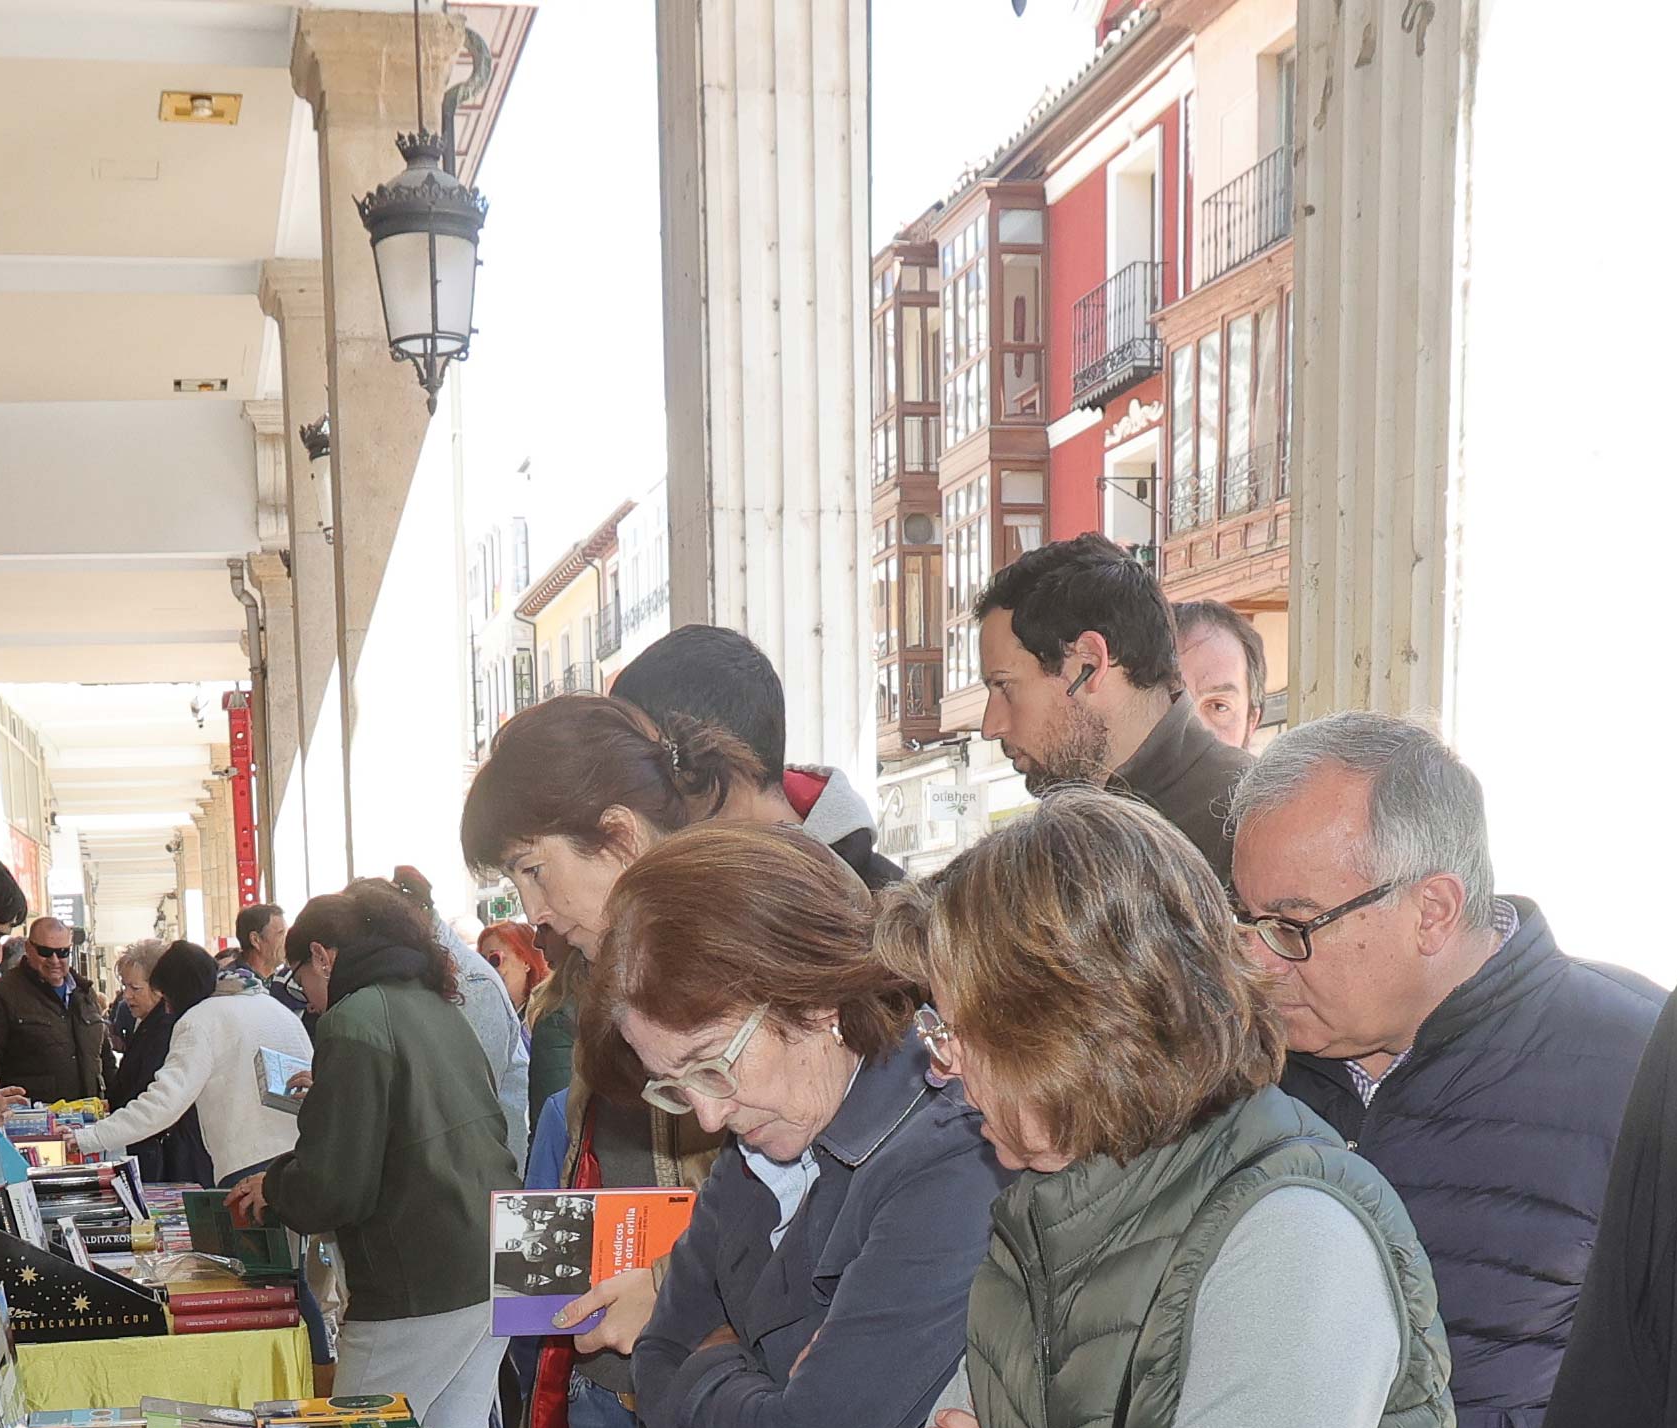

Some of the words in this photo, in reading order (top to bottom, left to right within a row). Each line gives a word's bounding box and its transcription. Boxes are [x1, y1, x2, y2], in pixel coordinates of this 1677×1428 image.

[626, 1206, 637, 1234] orilla
[611, 1221, 625, 1267] médicos
[624, 1236, 635, 1259] otra
